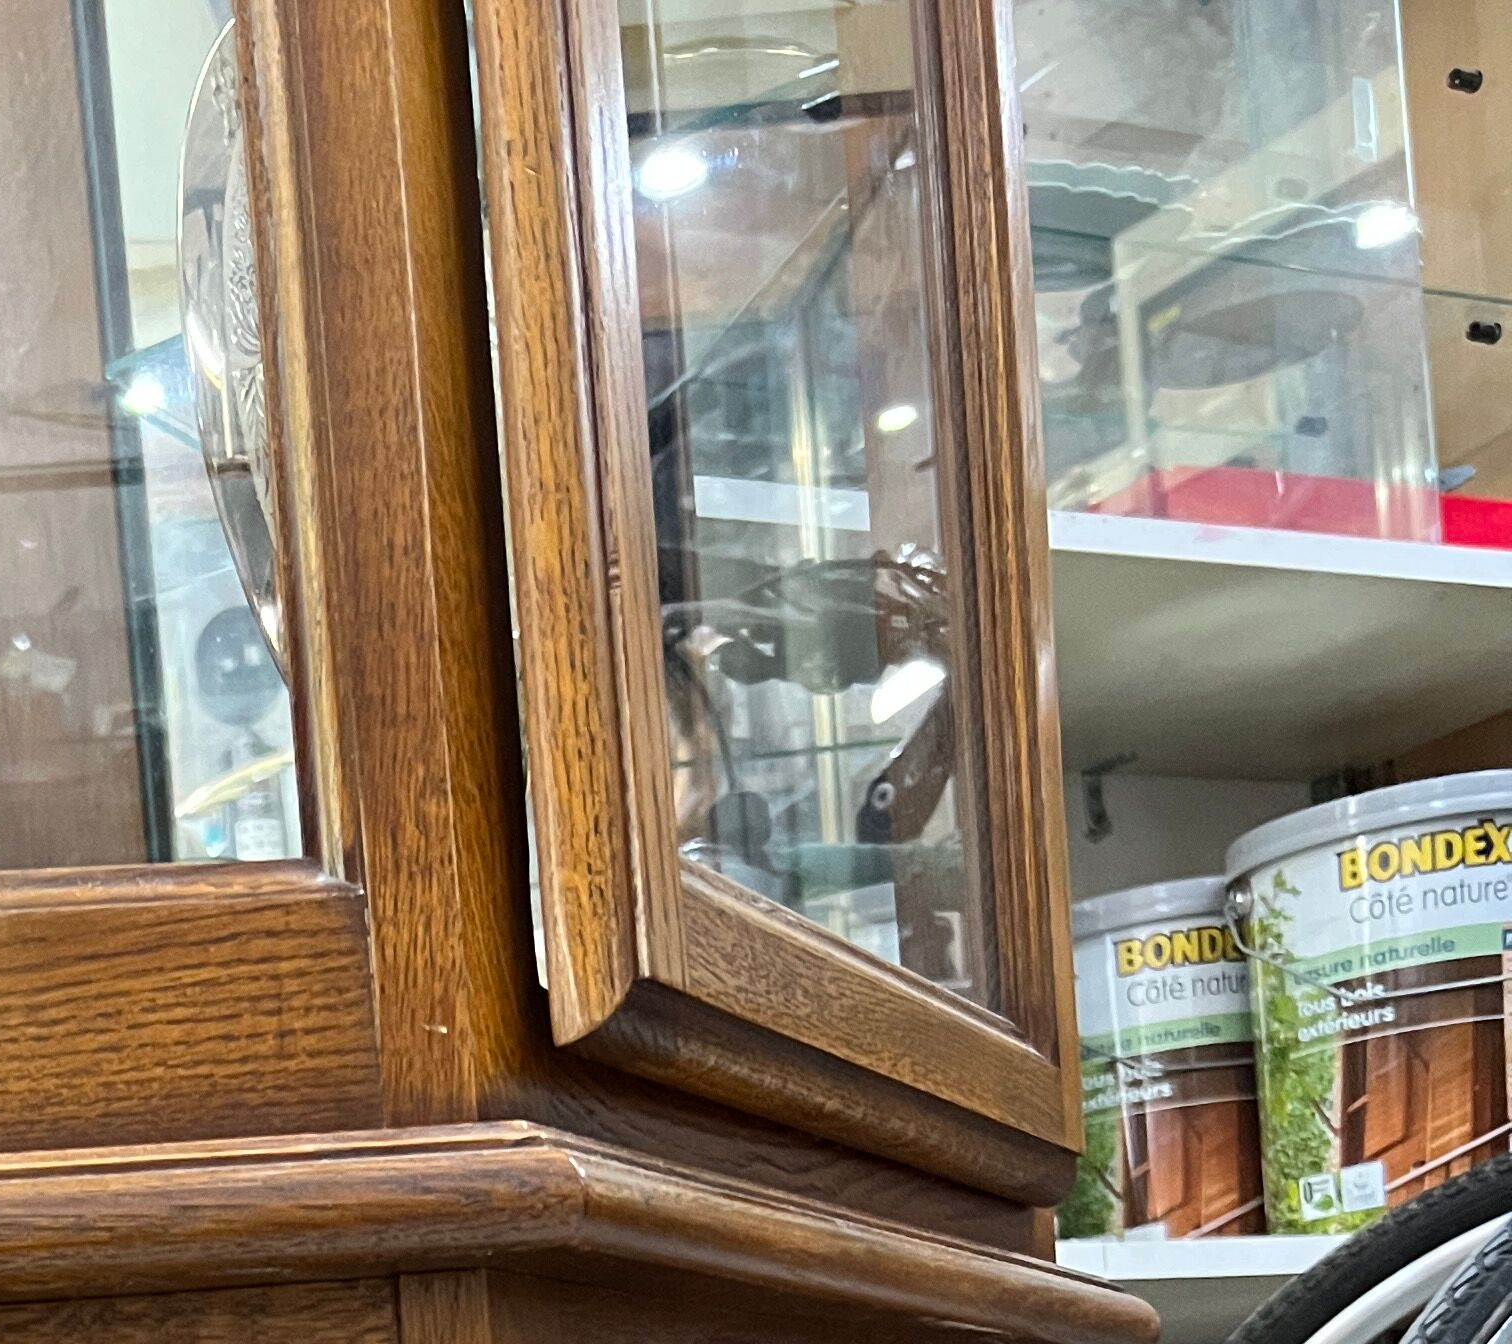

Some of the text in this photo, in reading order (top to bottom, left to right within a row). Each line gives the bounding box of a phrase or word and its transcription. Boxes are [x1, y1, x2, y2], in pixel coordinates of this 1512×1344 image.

[1338, 820, 1512, 891] BONDEX
[1349, 886, 1414, 924] Côté
[1359, 936, 1457, 970] naturelle
[1126, 971, 1247, 1007] Côté natur
